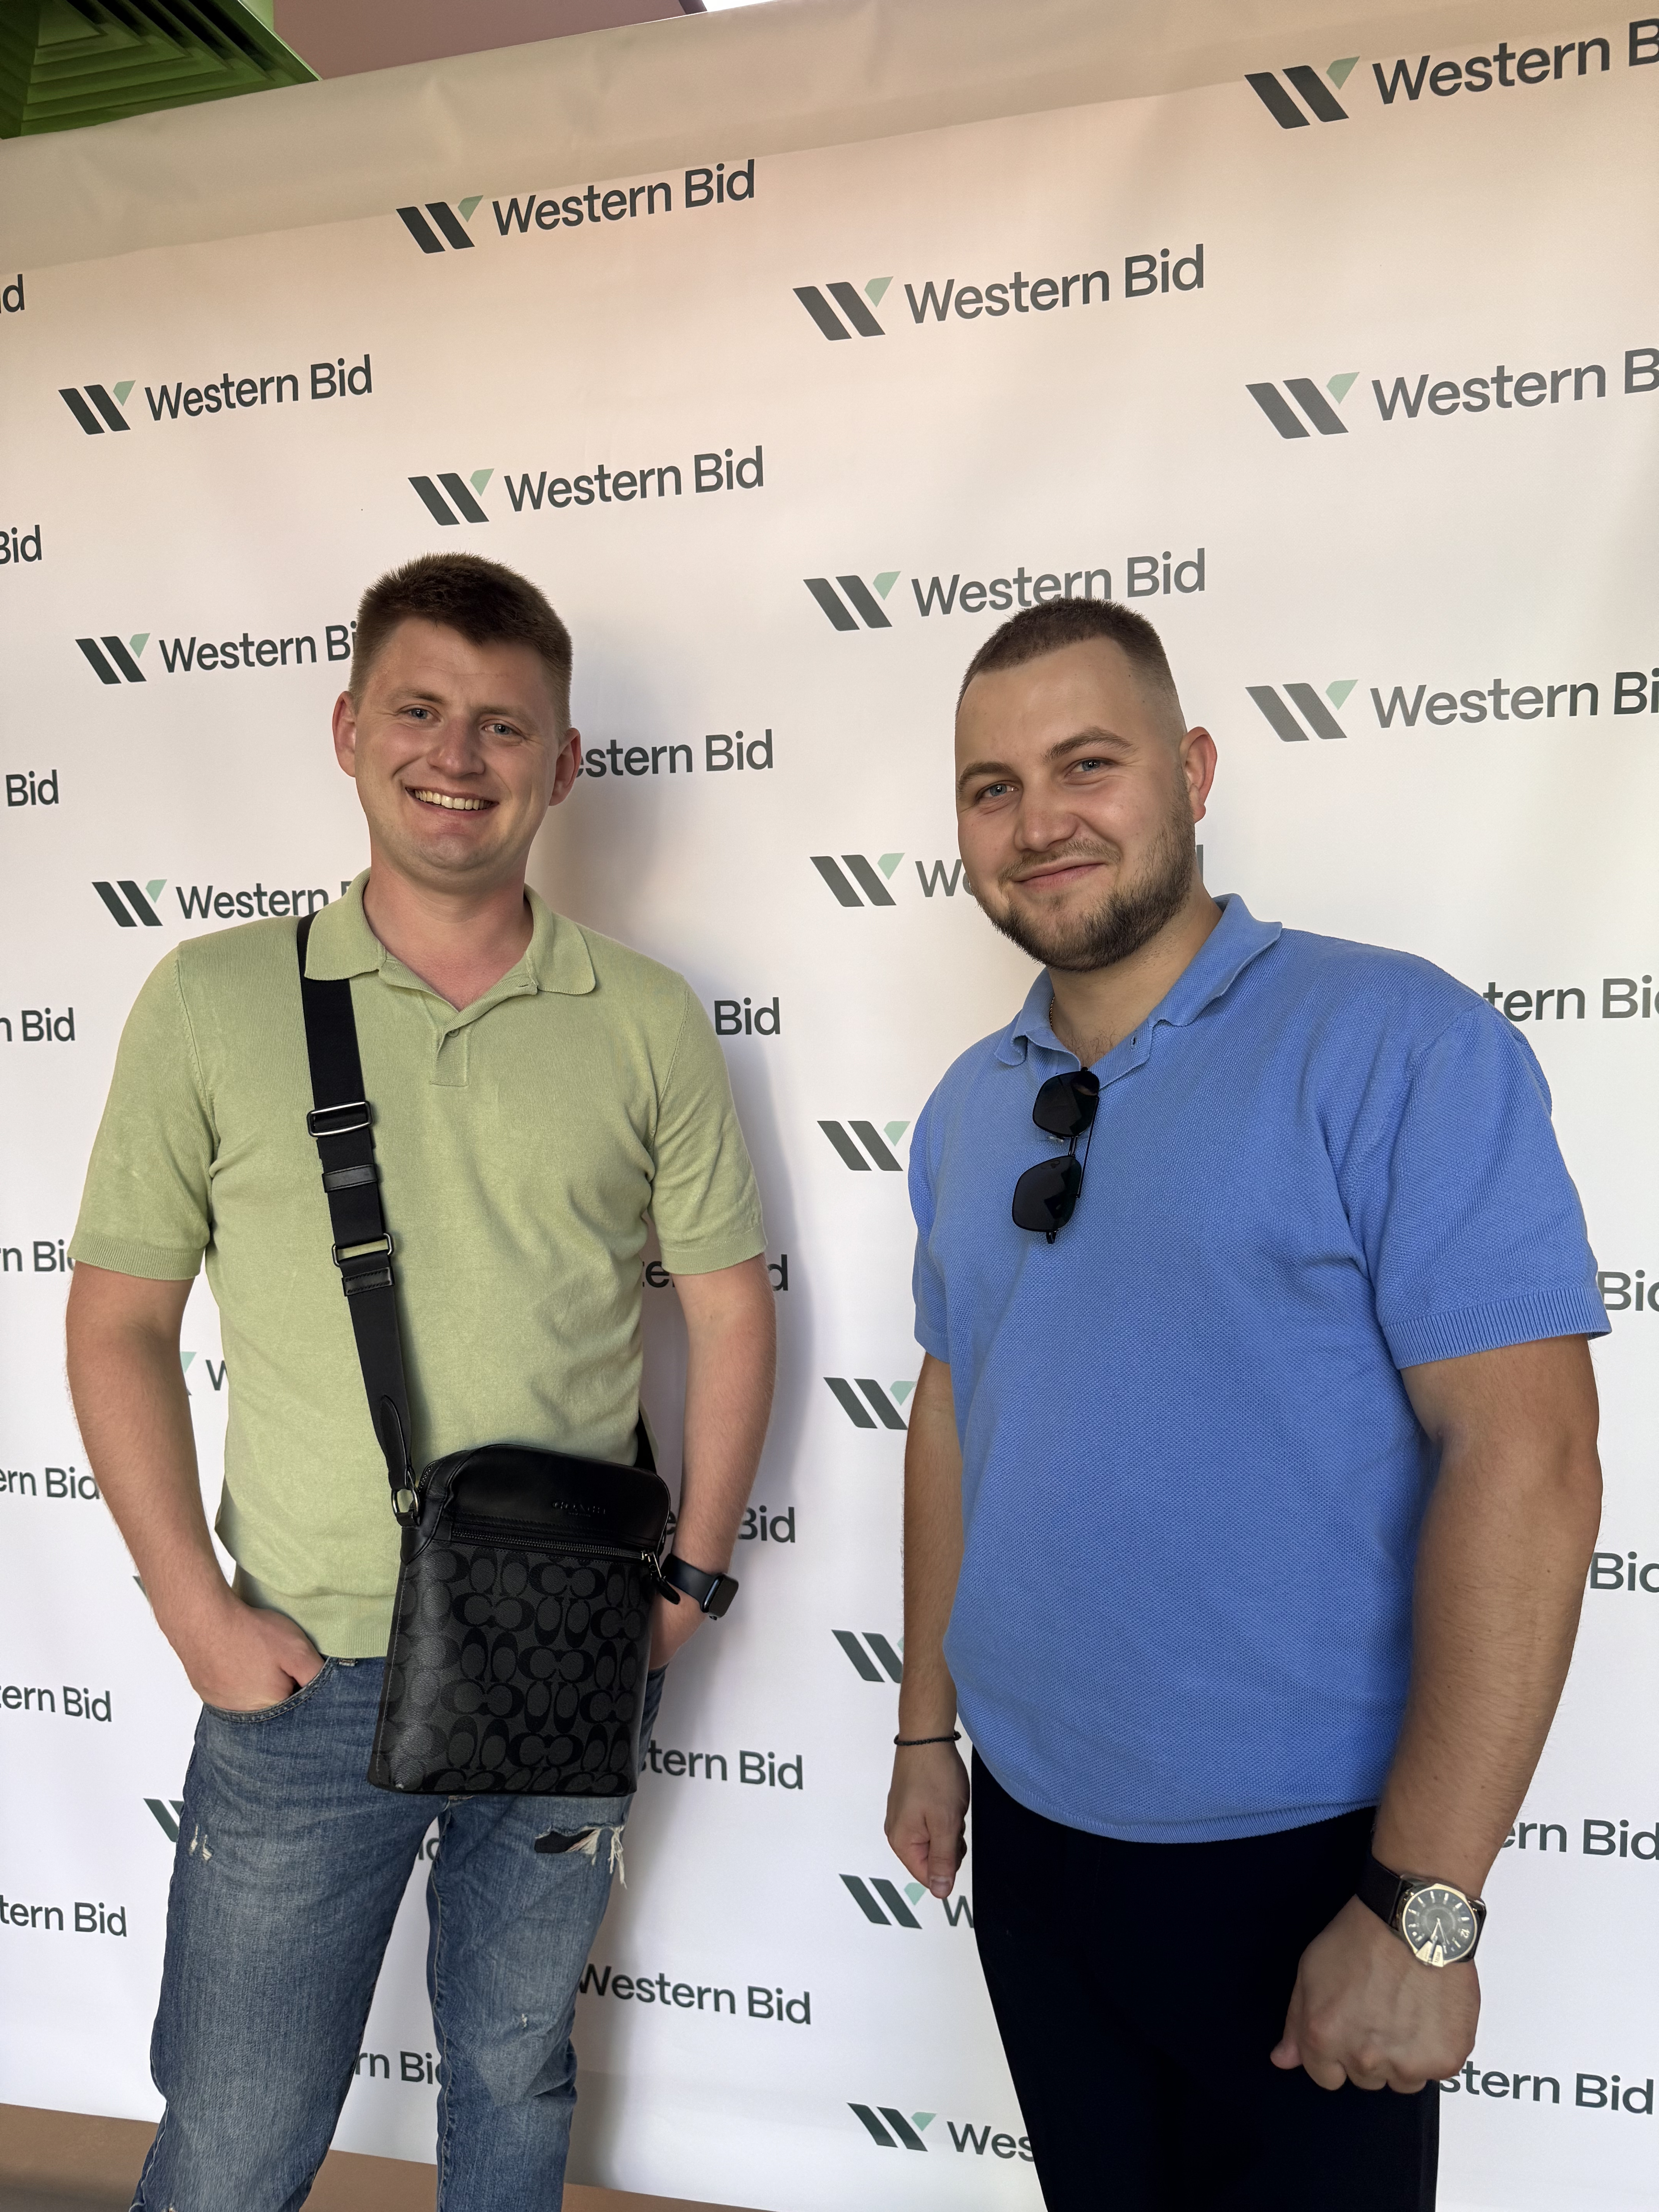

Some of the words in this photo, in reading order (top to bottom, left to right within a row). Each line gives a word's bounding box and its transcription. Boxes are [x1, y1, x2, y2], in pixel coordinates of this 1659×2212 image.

[1372, 38, 1609, 104] Western
[492, 183, 671, 235] Western
[685, 159, 754, 208] Bid
[904, 271, 1109, 323] Western
[1125, 244, 1203, 298] Bid
[145, 373, 298, 421] Western
[311, 354, 372, 399] Bid
[1372, 365, 1606, 421] Western
[504, 465, 681, 512] Western
[694, 445, 763, 493] Bid
[911, 567, 1111, 617] Western
[1128, 548, 1204, 598] Bid
[159, 633, 316, 673] Western
[1370, 678, 1598, 728] Western
[1614, 668, 1659, 714] Bi
[576, 740, 692, 778] stern
[706, 729, 773, 771] Bid
[6, 769, 58, 806] Bid
[176, 883, 329, 919] Western
[714, 997, 780, 1035] Bid
[1483, 982, 1585, 1022] tern
[1602, 975, 1659, 1018] Bi
[22, 1007, 75, 1041] Bid
[63, 1686, 112, 1722] Bid
[641, 1740, 727, 1781] tern
[740, 1750, 803, 1790] Bid
[1583, 1819, 1659, 1860] Bid
[0, 1895, 63, 1930] tern
[75, 1902, 127, 1937] Bid
[580, 1963, 736, 2014] Western
[748, 1986, 811, 2025] Bid
[400, 2051, 441, 2084] Bi
[1440, 2060, 1560, 2104] stern
[1576, 2073, 1653, 2114] Bid
